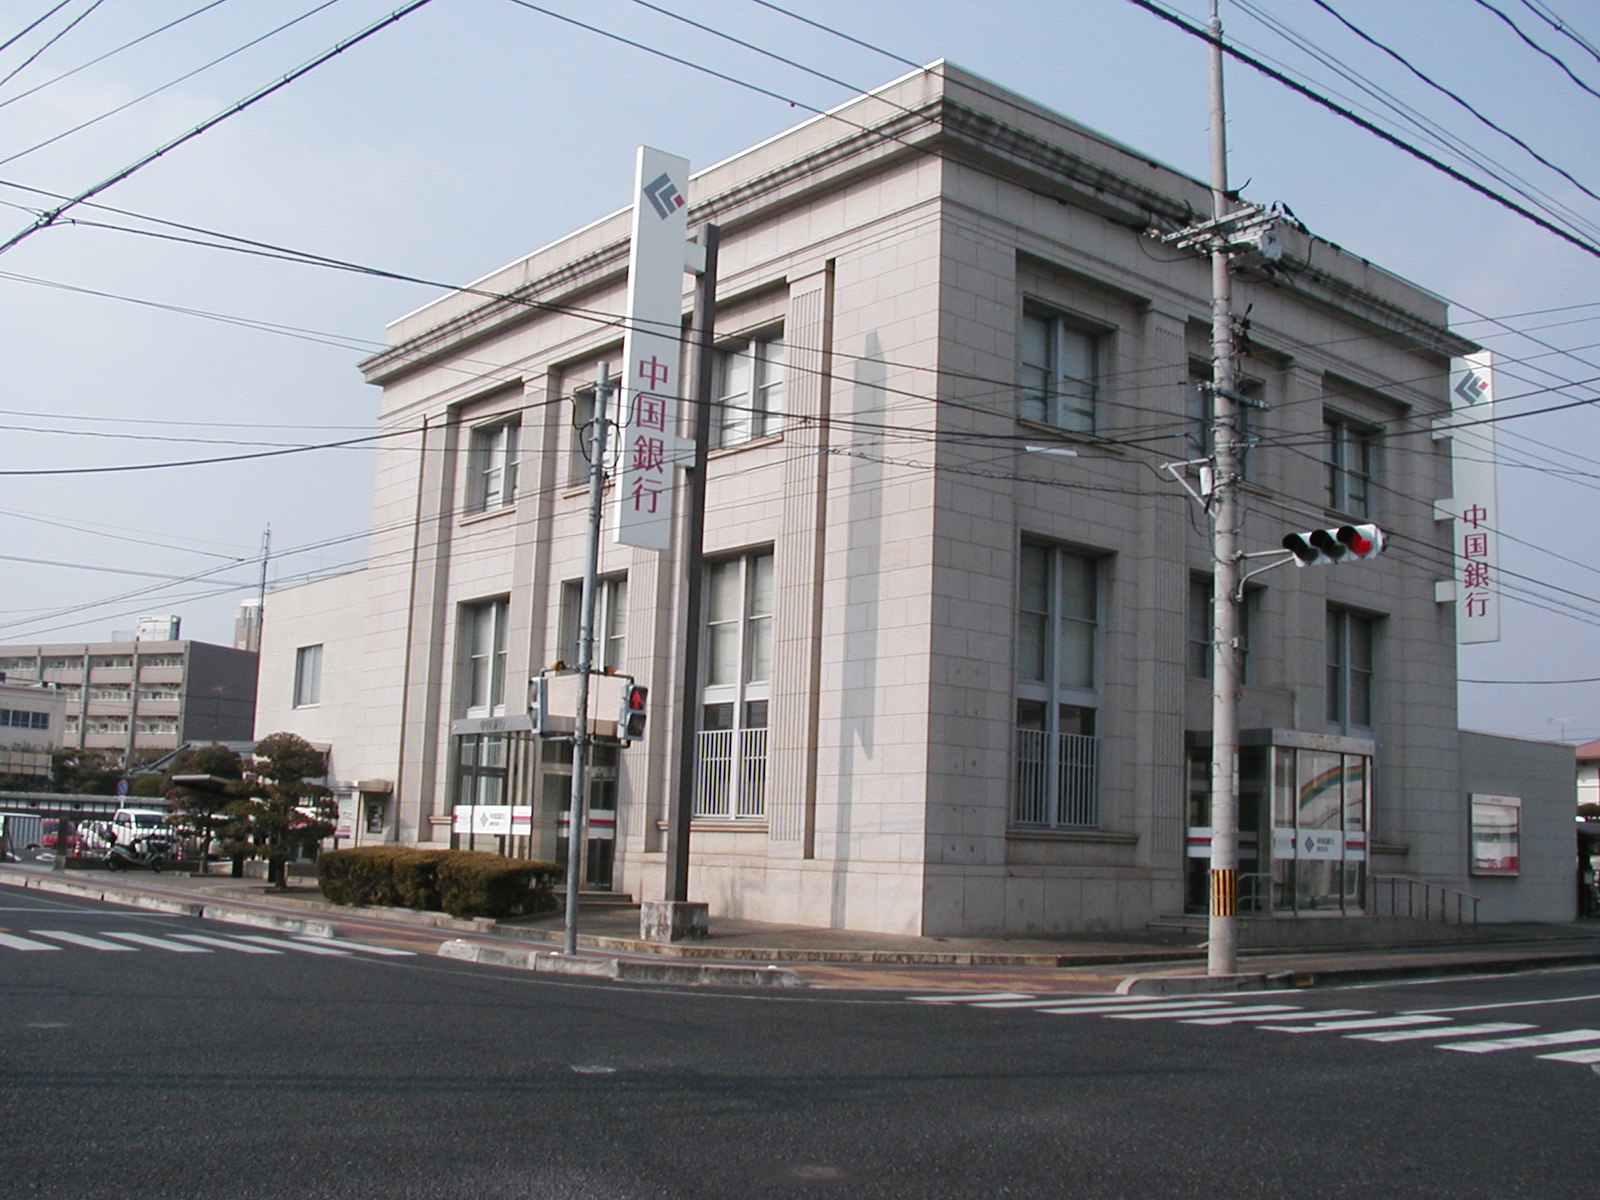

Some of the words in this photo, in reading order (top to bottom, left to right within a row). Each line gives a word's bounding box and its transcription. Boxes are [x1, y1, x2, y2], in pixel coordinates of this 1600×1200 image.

[632, 355, 668, 514] 中国銀行
[1463, 504, 1490, 618] 中国銀行
